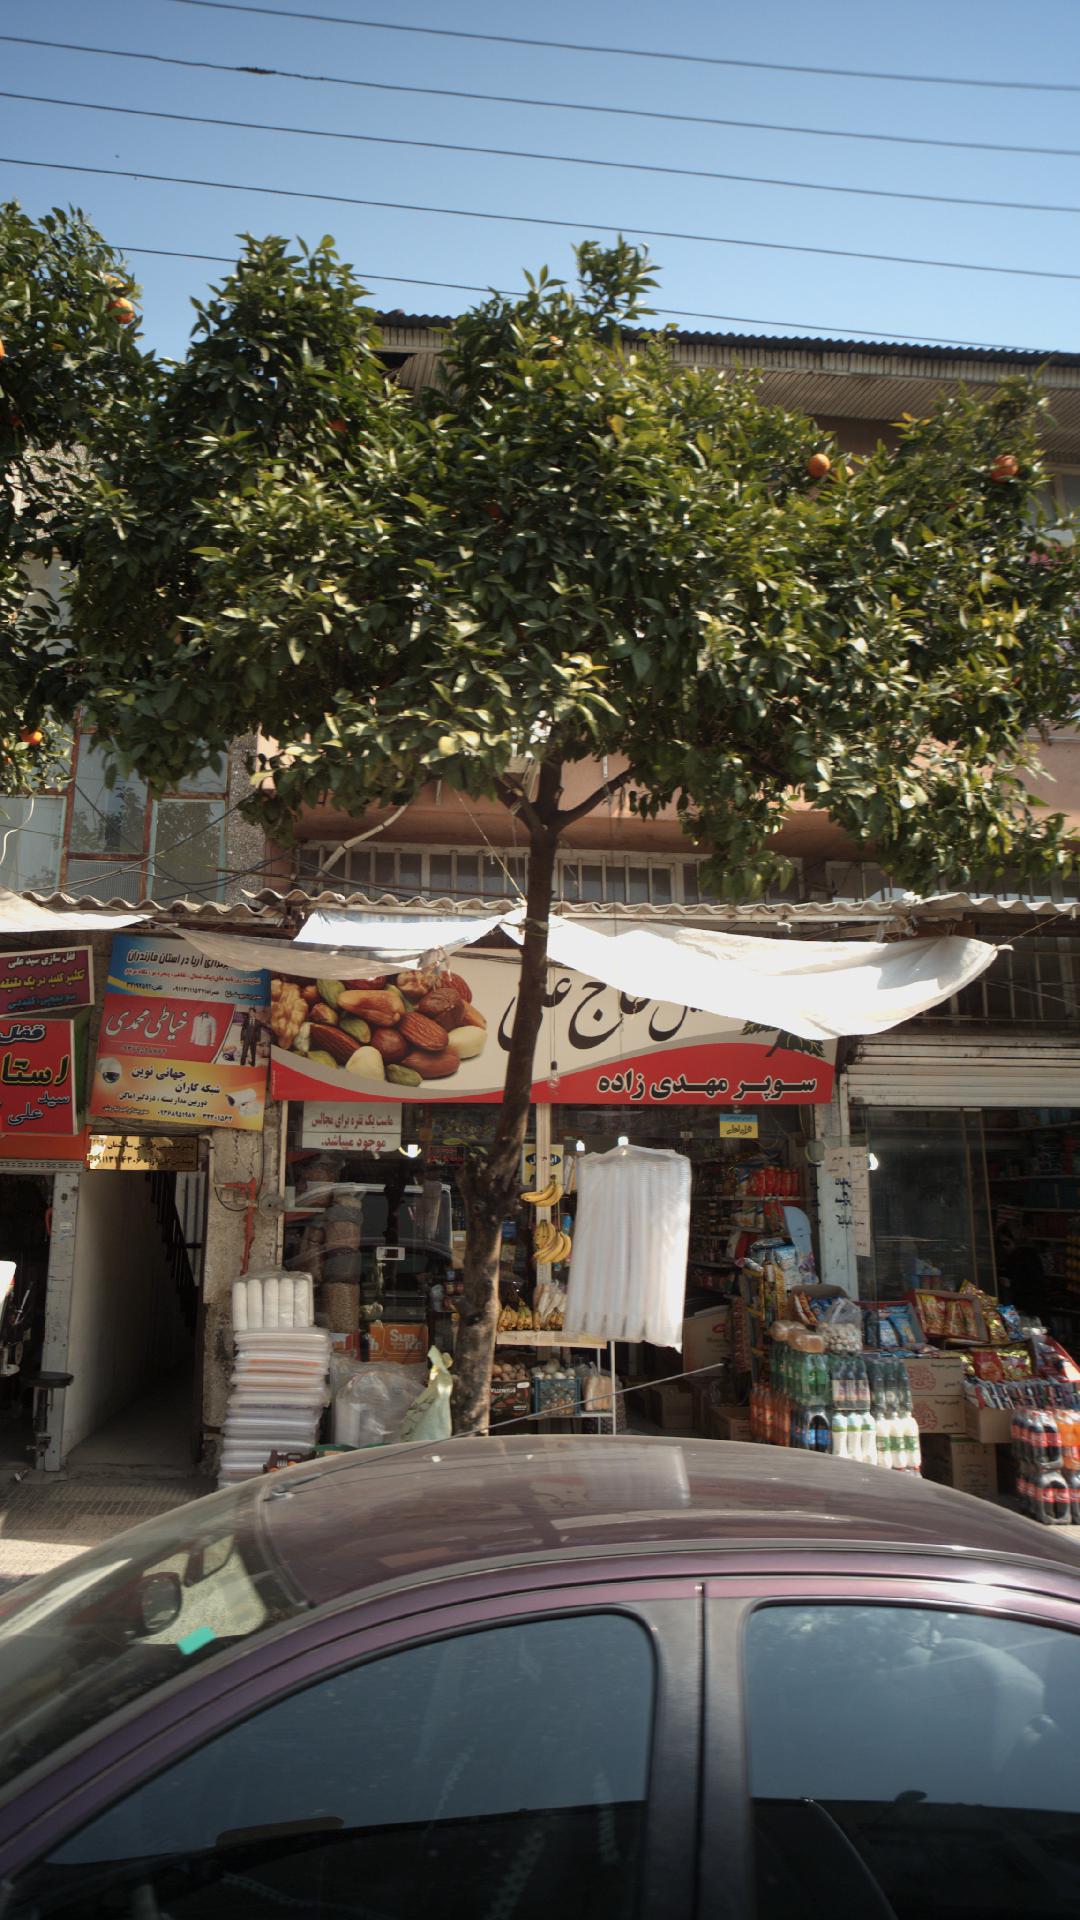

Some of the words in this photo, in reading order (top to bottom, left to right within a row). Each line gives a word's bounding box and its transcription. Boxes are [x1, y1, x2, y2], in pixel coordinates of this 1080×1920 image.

[8, 957, 24, 968] علی
[26, 957, 40, 966] سید
[41, 954, 61, 965] سازی
[127, 949, 159, 963] مازندران
[159, 952, 181, 964] استان
[24, 976, 35, 990] یک
[37, 976, 46, 987] در
[48, 973, 64, 987] کلید
[65, 969, 85, 985] تکثیر
[105, 1008, 150, 1036] محمدی
[0, 1023, 46, 1044] قفل
[131, 1066, 153, 1079] نوین
[156, 1067, 186, 1081] جهانی
[174, 1081, 199, 1094] کاران
[200, 1084, 221, 1096] شبکه
[597, 1067, 646, 1100] زاده
[650, 1072, 729, 1099] مهدی
[730, 1074, 817, 1101] سوپر
[37, 1090, 70, 1107] سید
[186, 1099, 208, 1108] دوربین
[8, 1102, 43, 1125] علی
[311, 1111, 334, 1128] مجالس
[376, 1114, 394, 1126] ماست
[335, 1113, 350, 1129] برای
[364, 1113, 376, 1129] یک
[357, 1137, 386, 1152] موجود
